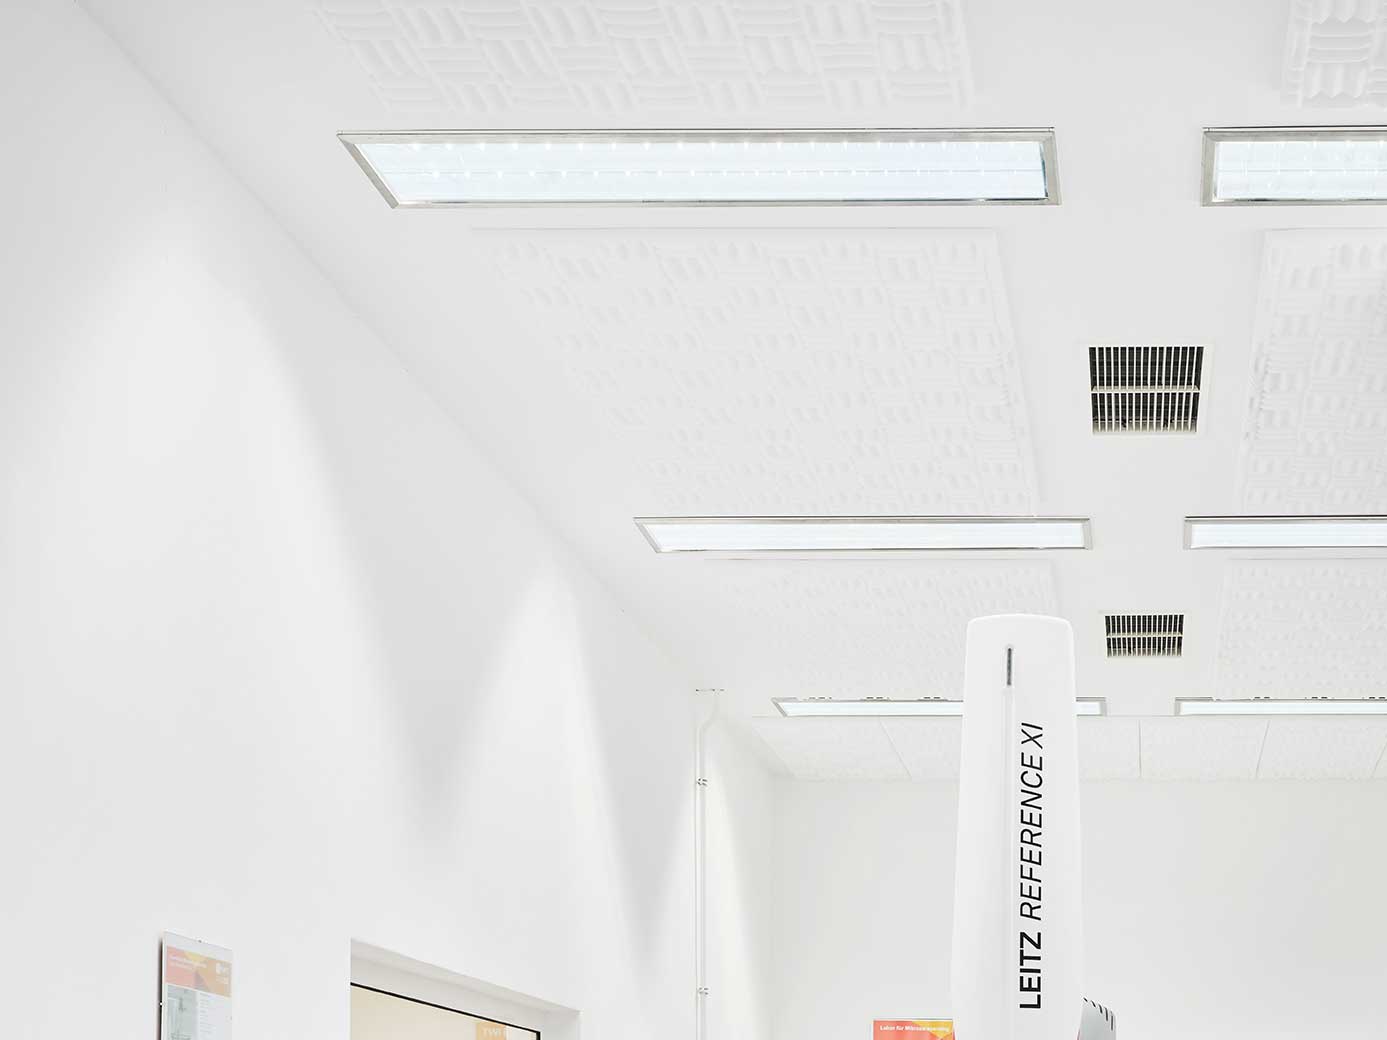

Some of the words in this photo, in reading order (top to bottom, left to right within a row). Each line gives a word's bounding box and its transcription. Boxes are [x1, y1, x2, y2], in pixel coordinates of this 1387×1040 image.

[1021, 722, 1043, 749] XI
[1020, 752, 1043, 921] REFERENCE
[1019, 931, 1041, 1009] LEITZ
